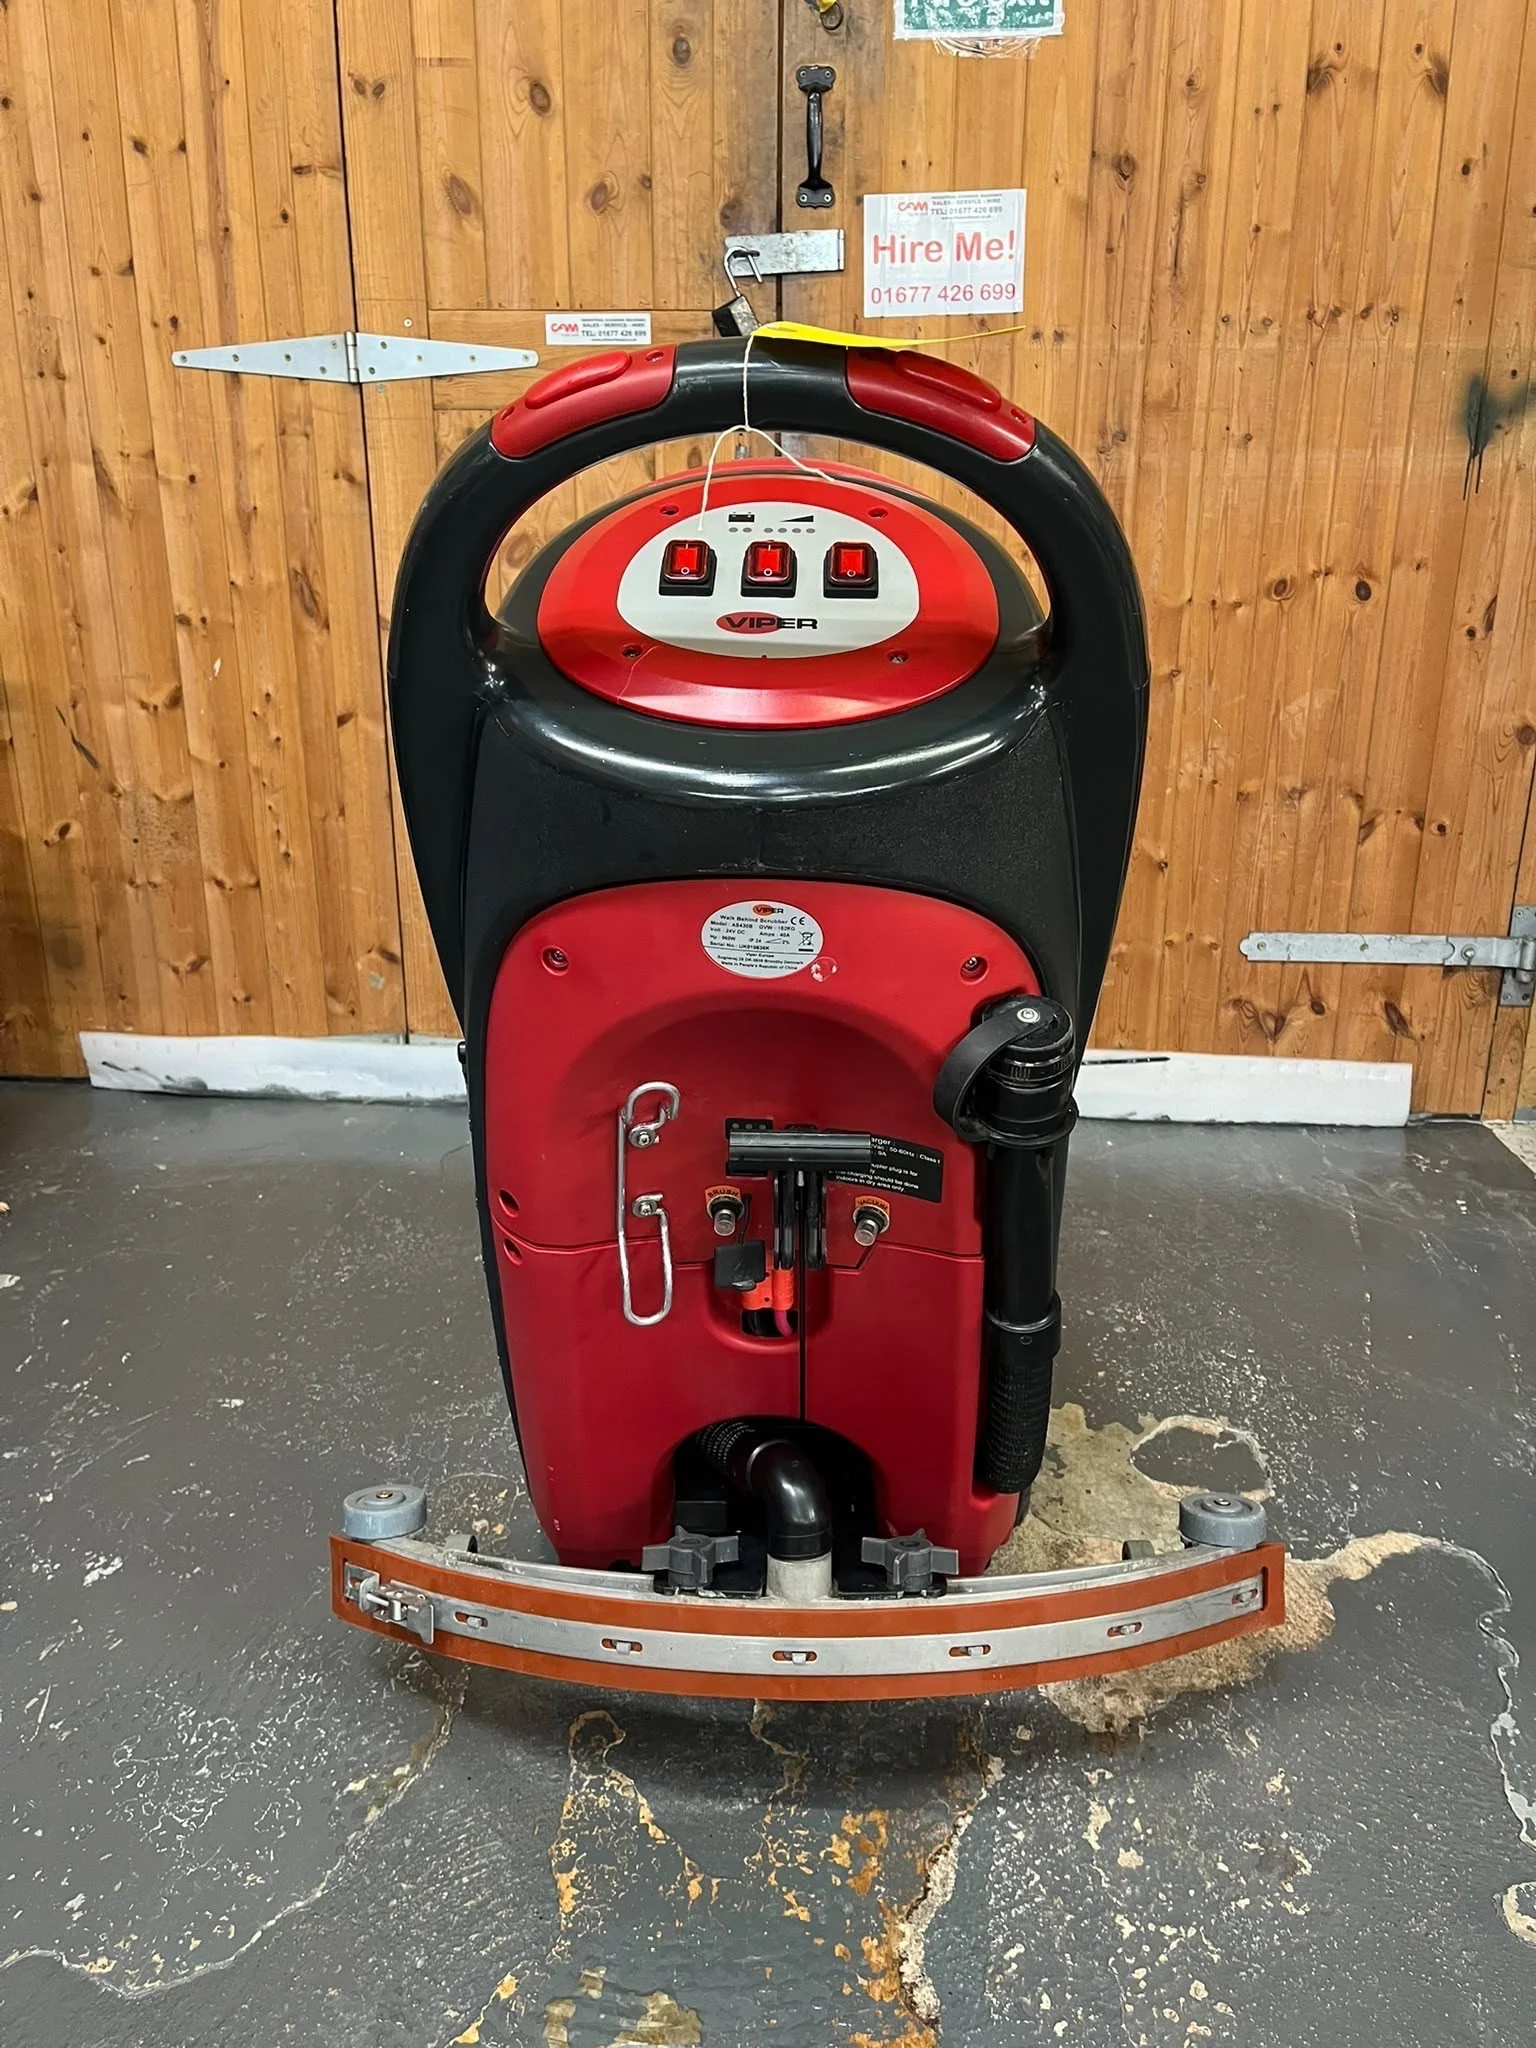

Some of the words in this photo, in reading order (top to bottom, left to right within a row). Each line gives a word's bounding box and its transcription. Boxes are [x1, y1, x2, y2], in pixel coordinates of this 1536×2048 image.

[873, 234, 943, 264] Hire
[956, 230, 1015, 262] Me!
[871, 286, 932, 304] 01677
[937, 284, 974, 302] 426
[980, 282, 1016, 301] 699
[724, 616, 819, 630] VIPER
[919, 1154, 937, 1163] Class
[888, 1165, 902, 1174] plug
[846, 1170, 873, 1180] charging
[874, 1175, 894, 1183] should
[707, 1189, 739, 1198] BRUSH
